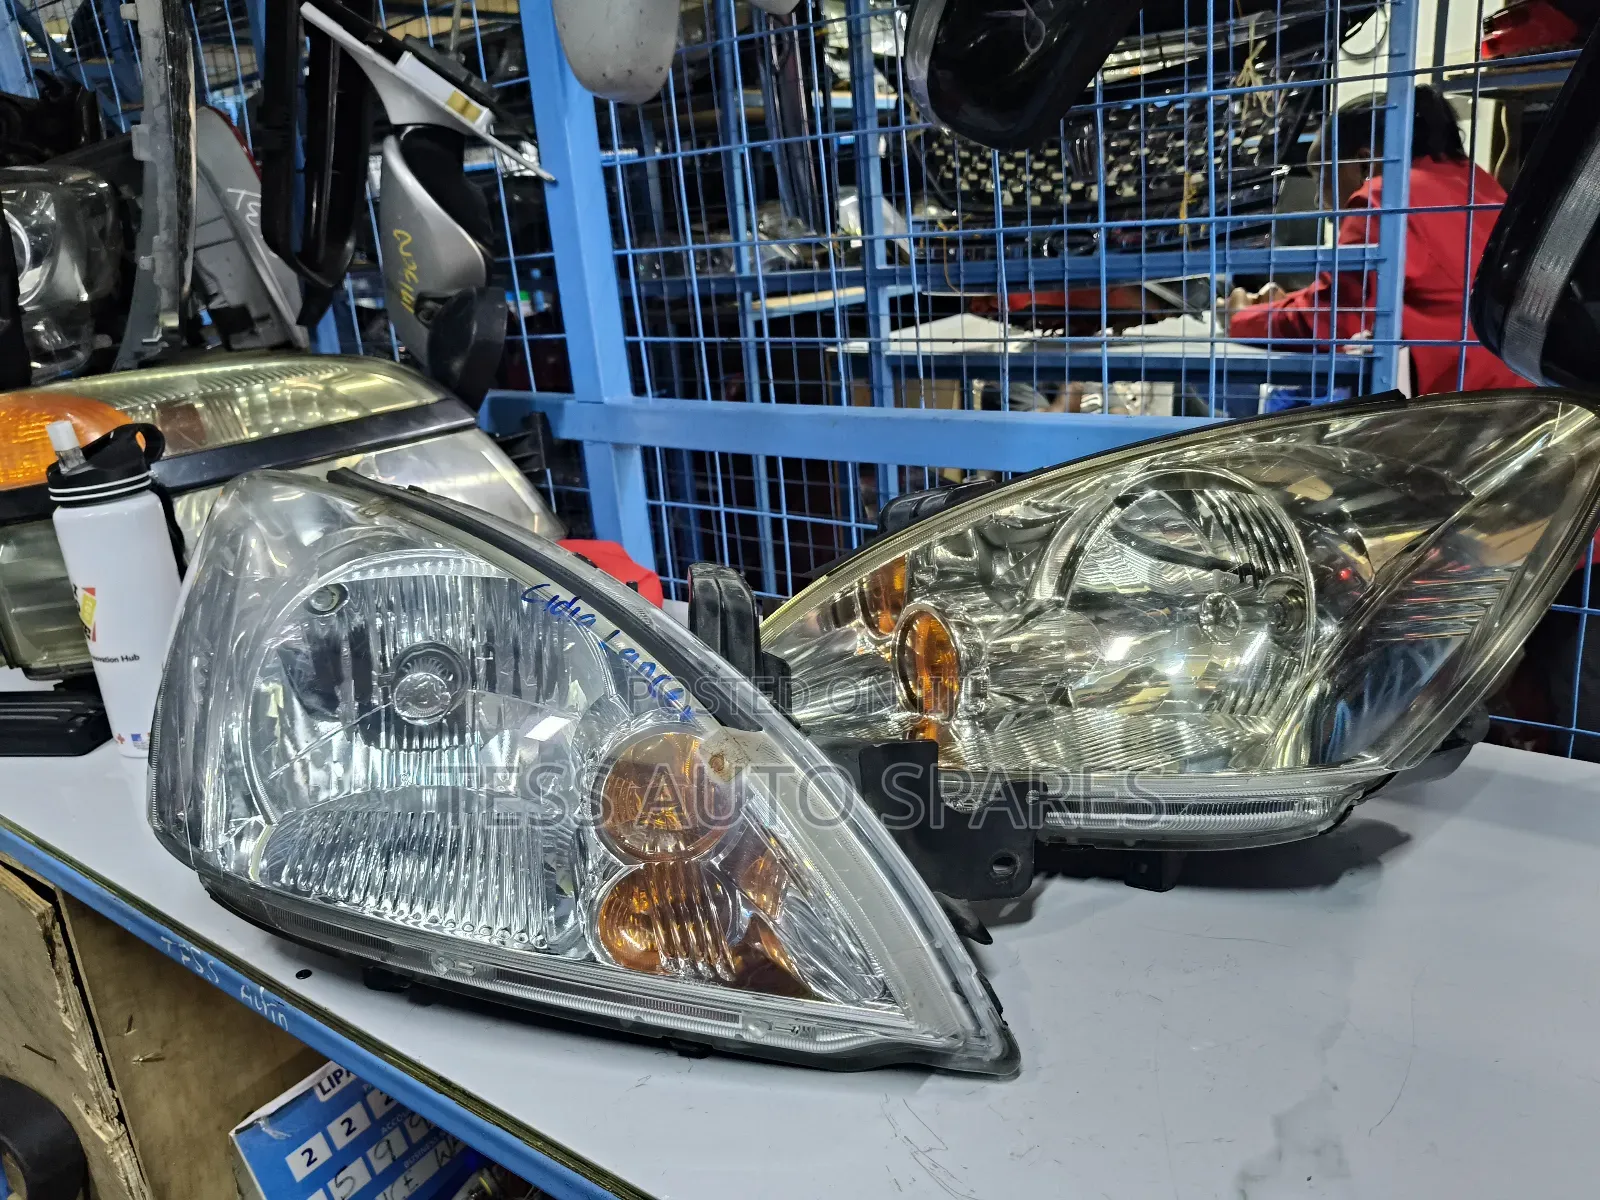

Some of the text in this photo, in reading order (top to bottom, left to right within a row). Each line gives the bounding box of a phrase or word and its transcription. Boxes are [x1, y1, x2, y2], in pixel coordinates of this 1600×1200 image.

[120, 654, 140, 662] Hub
[301, 1147, 318, 1168] 2
[340, 1117, 357, 1138] 2
